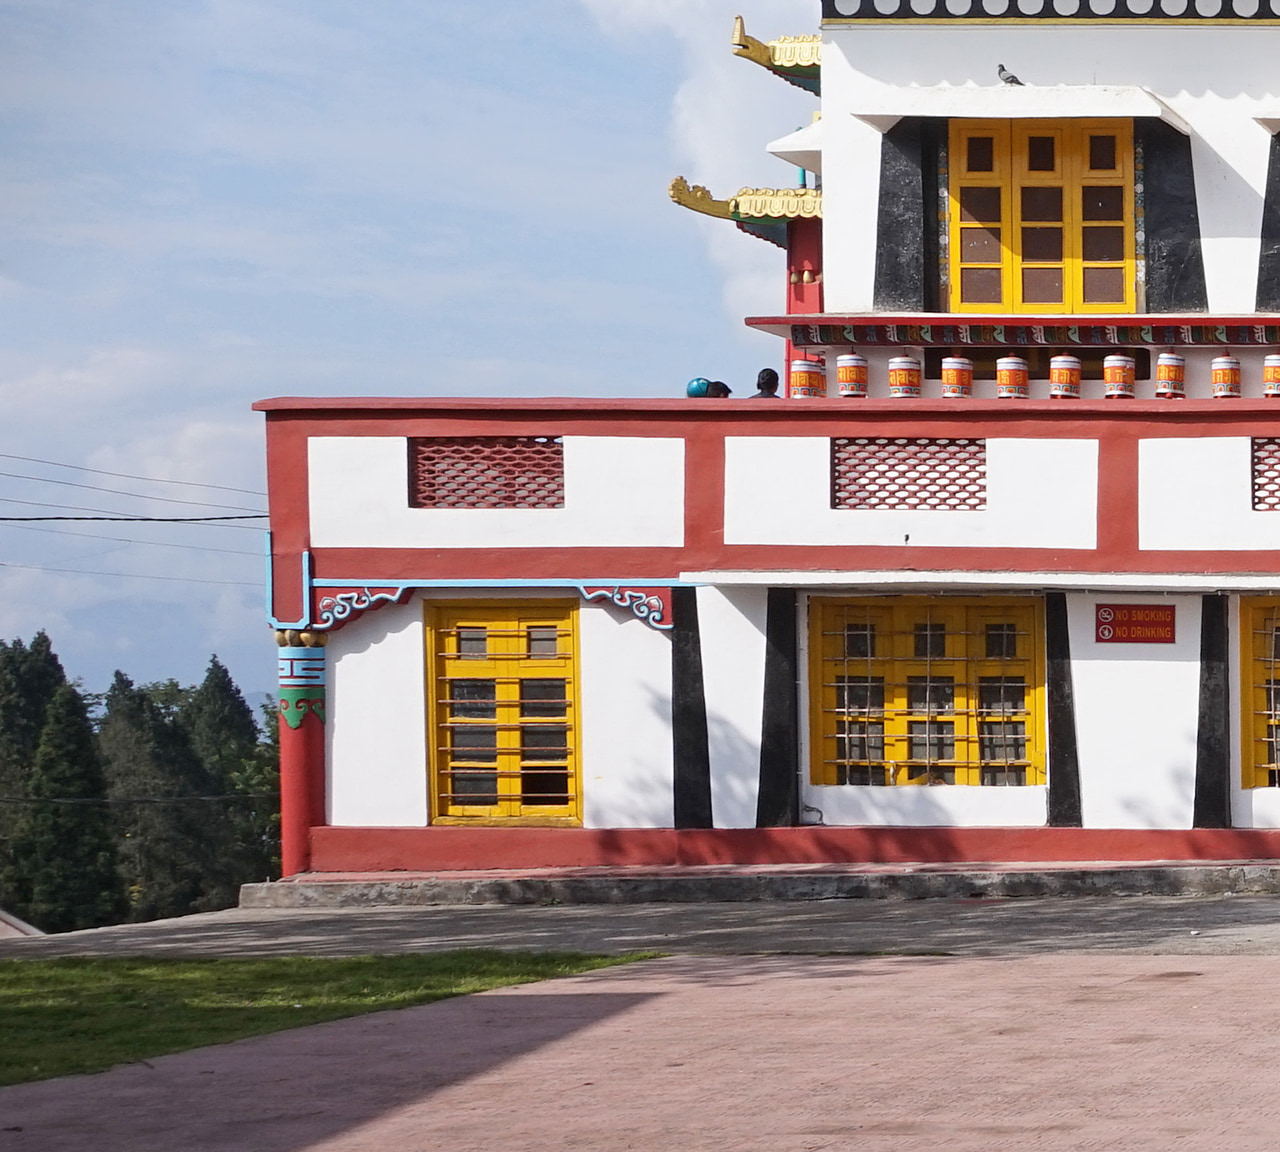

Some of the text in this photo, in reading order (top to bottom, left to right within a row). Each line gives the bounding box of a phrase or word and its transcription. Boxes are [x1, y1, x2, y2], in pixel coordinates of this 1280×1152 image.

[1115, 610, 1171, 622] NO SMOKING
[1115, 627, 1171, 638] NO DRINKING
